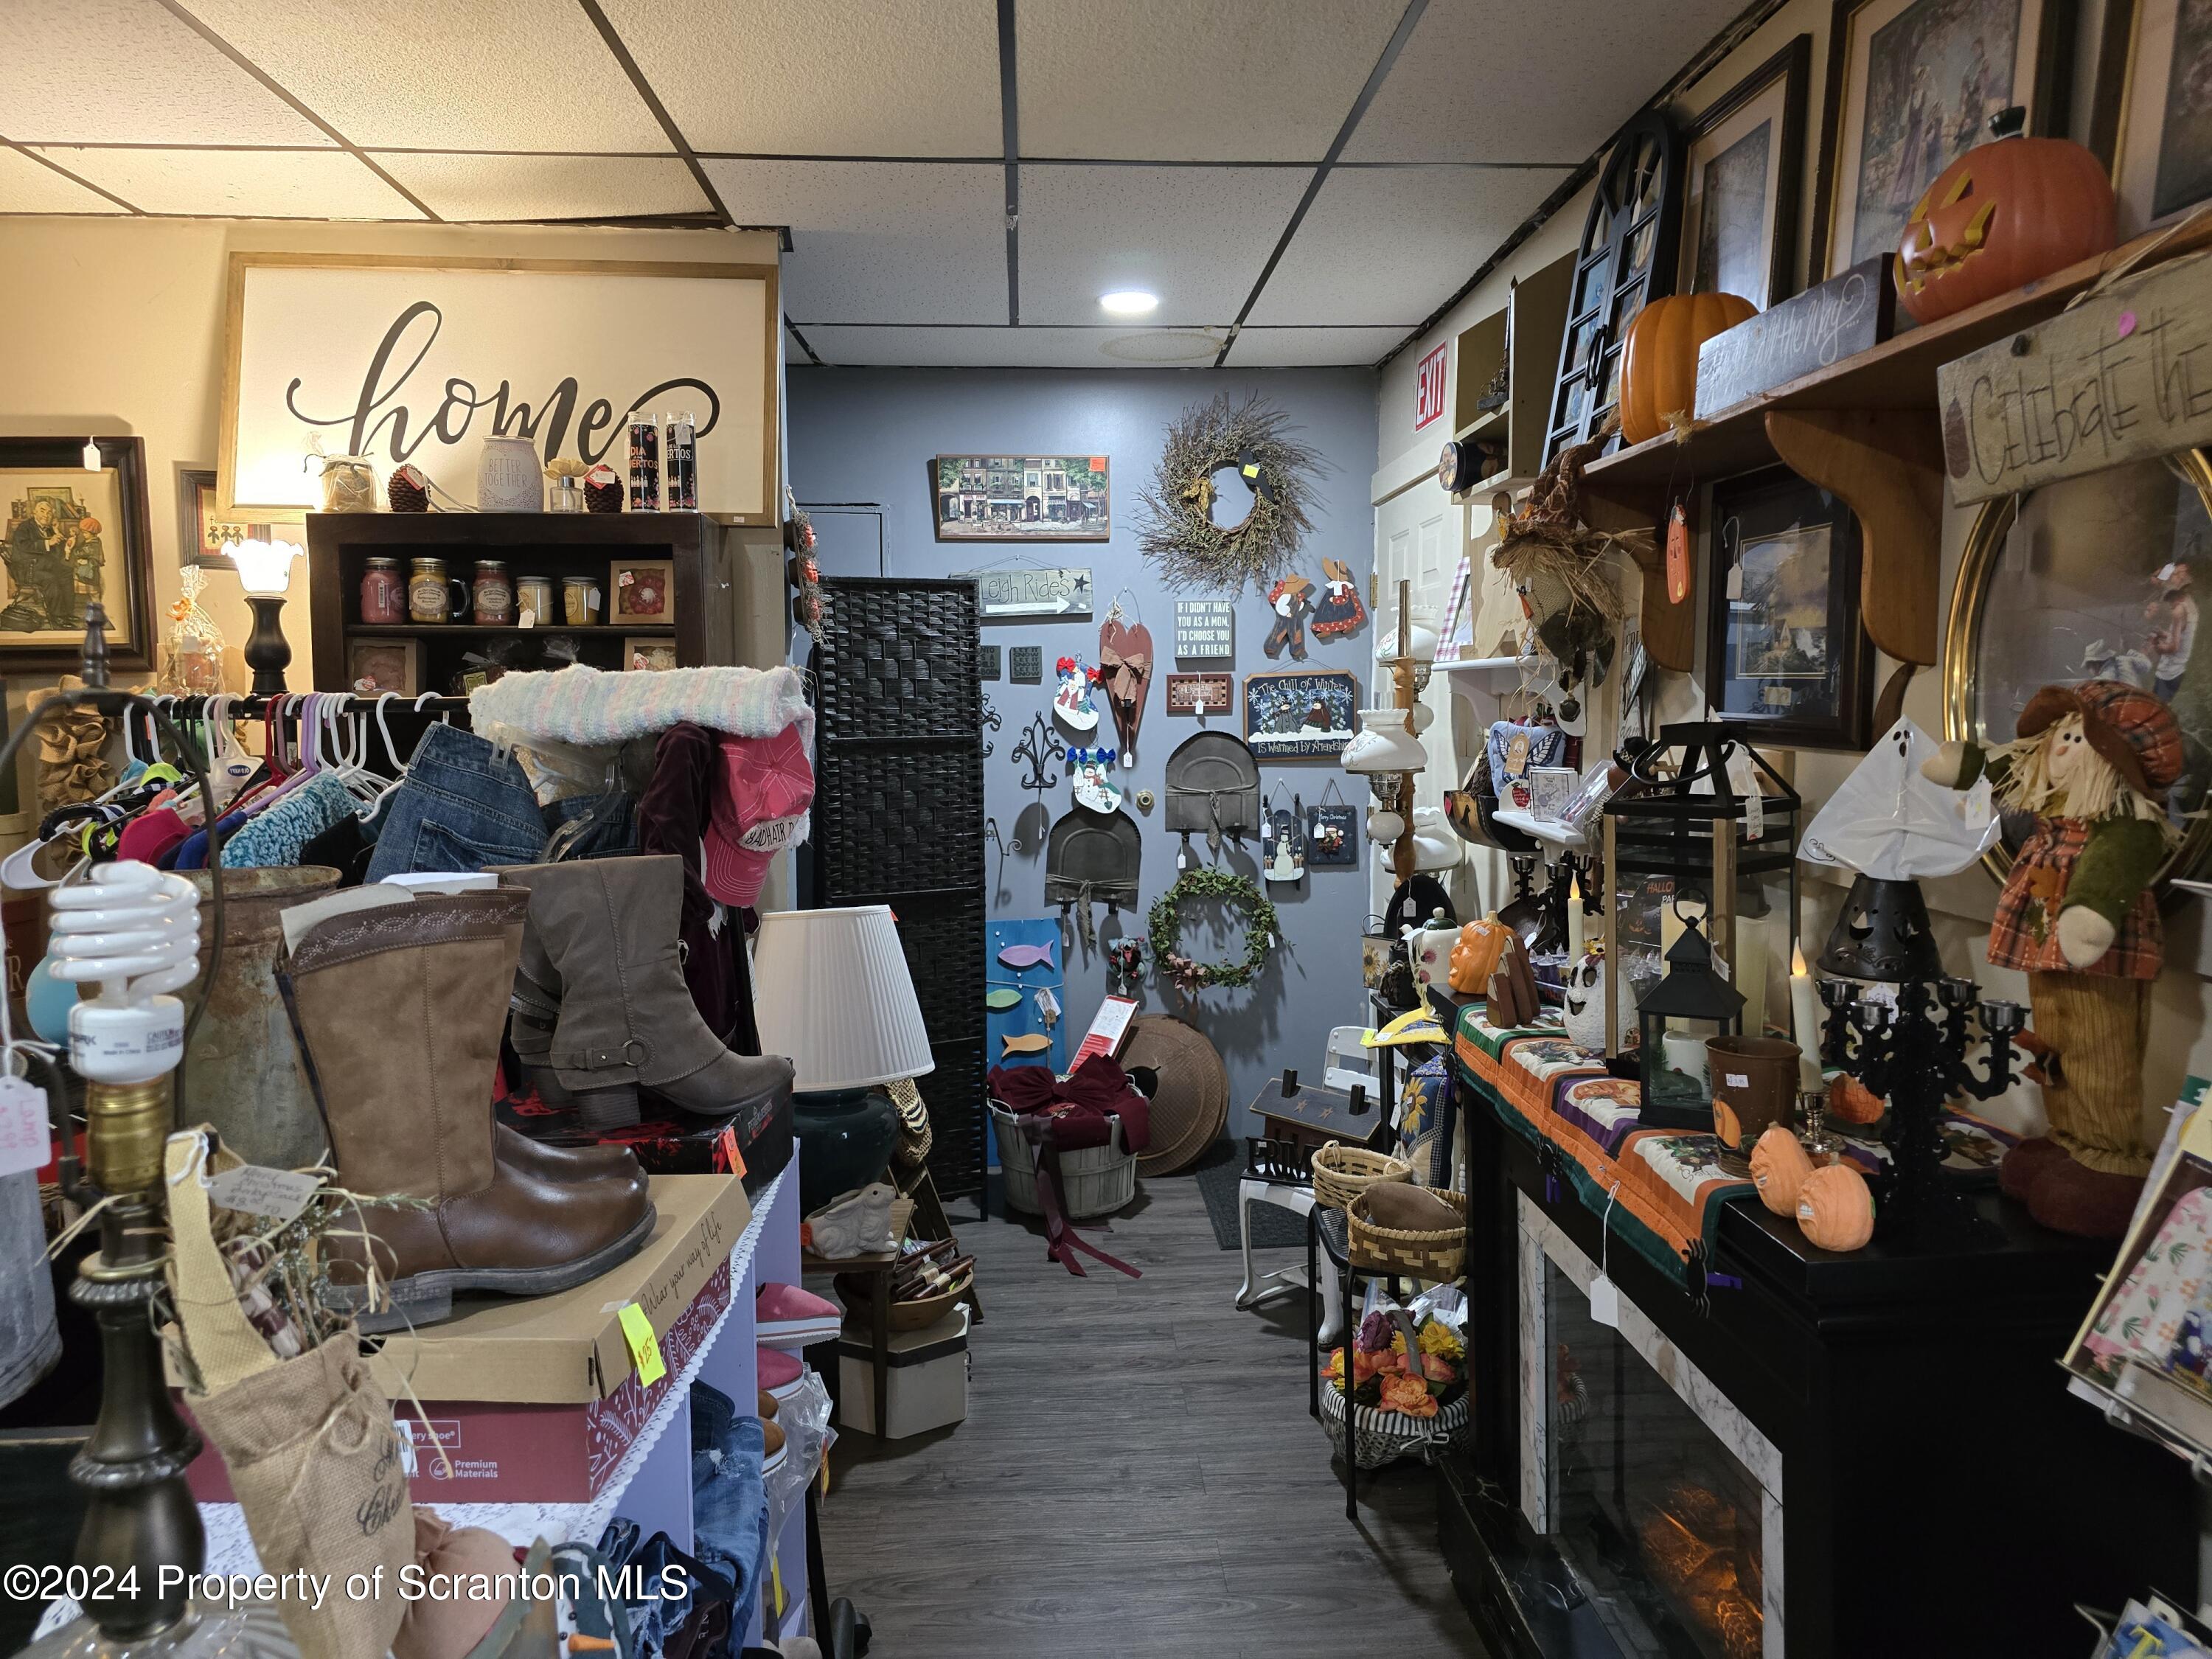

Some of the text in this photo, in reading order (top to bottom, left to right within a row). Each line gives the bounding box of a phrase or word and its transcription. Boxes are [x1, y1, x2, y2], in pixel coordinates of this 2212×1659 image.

[287, 301, 720, 463] home
[1416, 348, 1444, 425] EXIT
[630, 446, 646, 456] DIA
[489, 458, 521, 473] BETTER
[1023, 572, 1071, 600] Rides
[1178, 602, 1230, 613] IF I DIDN'T HAVE
[1178, 616, 1230, 627] YOU AS A MOM,
[1178, 630, 1230, 641] I'D CHOOSE YOU
[1178, 644, 1230, 655] AS A FRIEND
[1258, 678, 1344, 695] The Chill of Winter
[1268, 742, 1298, 754] Warmed
[1300, 741, 1310, 754] by
[669, 1264, 685, 1300] your
[686, 1248, 702, 1267] way
[701, 1222, 711, 1256] of
[709, 1211, 722, 1244] life
[412, 1433, 425, 1441] ery
[455, 1460, 498, 1469] Premium
[455, 1470, 498, 1478] Materials
